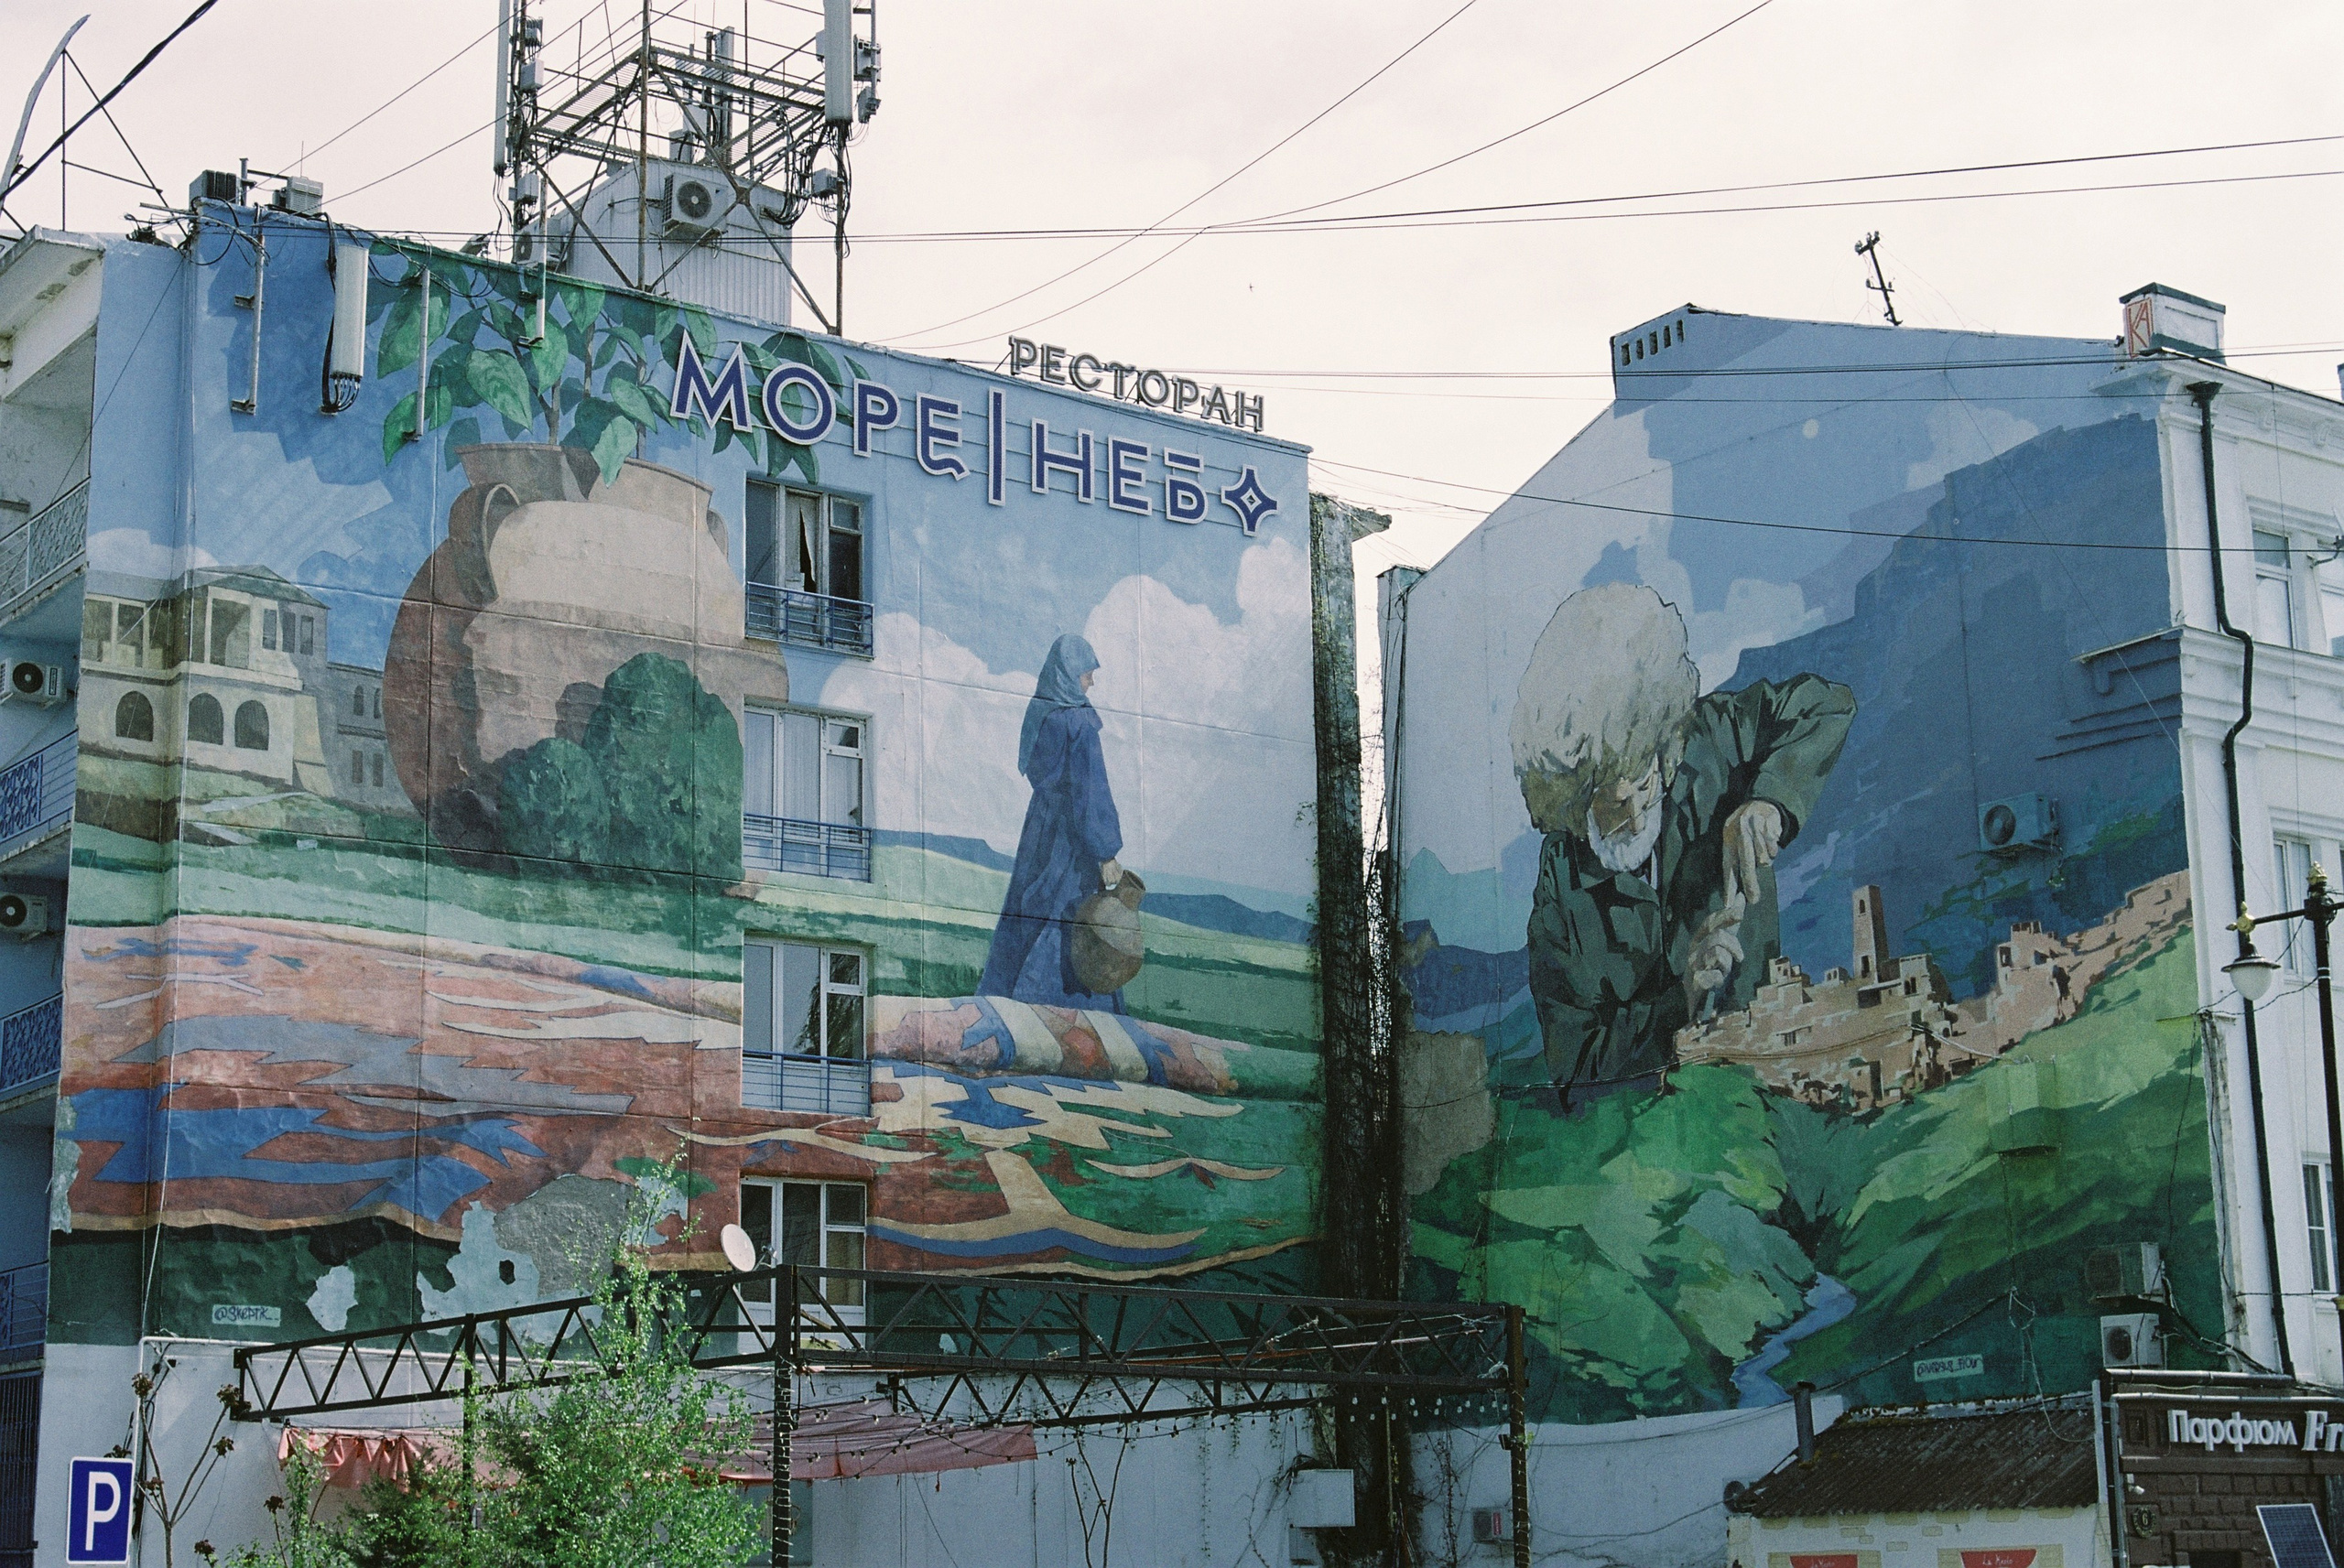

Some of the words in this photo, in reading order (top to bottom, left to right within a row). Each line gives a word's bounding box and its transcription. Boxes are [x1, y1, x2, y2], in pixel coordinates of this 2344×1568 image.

[669, 329, 971, 481] МОРЕ
[1008, 335, 1264, 432] РЕСТОРАН
[2167, 1410, 2298, 1453] Парфюм
[2301, 1410, 2344, 1453] Fr
[85, 1471, 122, 1551] P
[2142, 1512, 2149, 1526] 6
